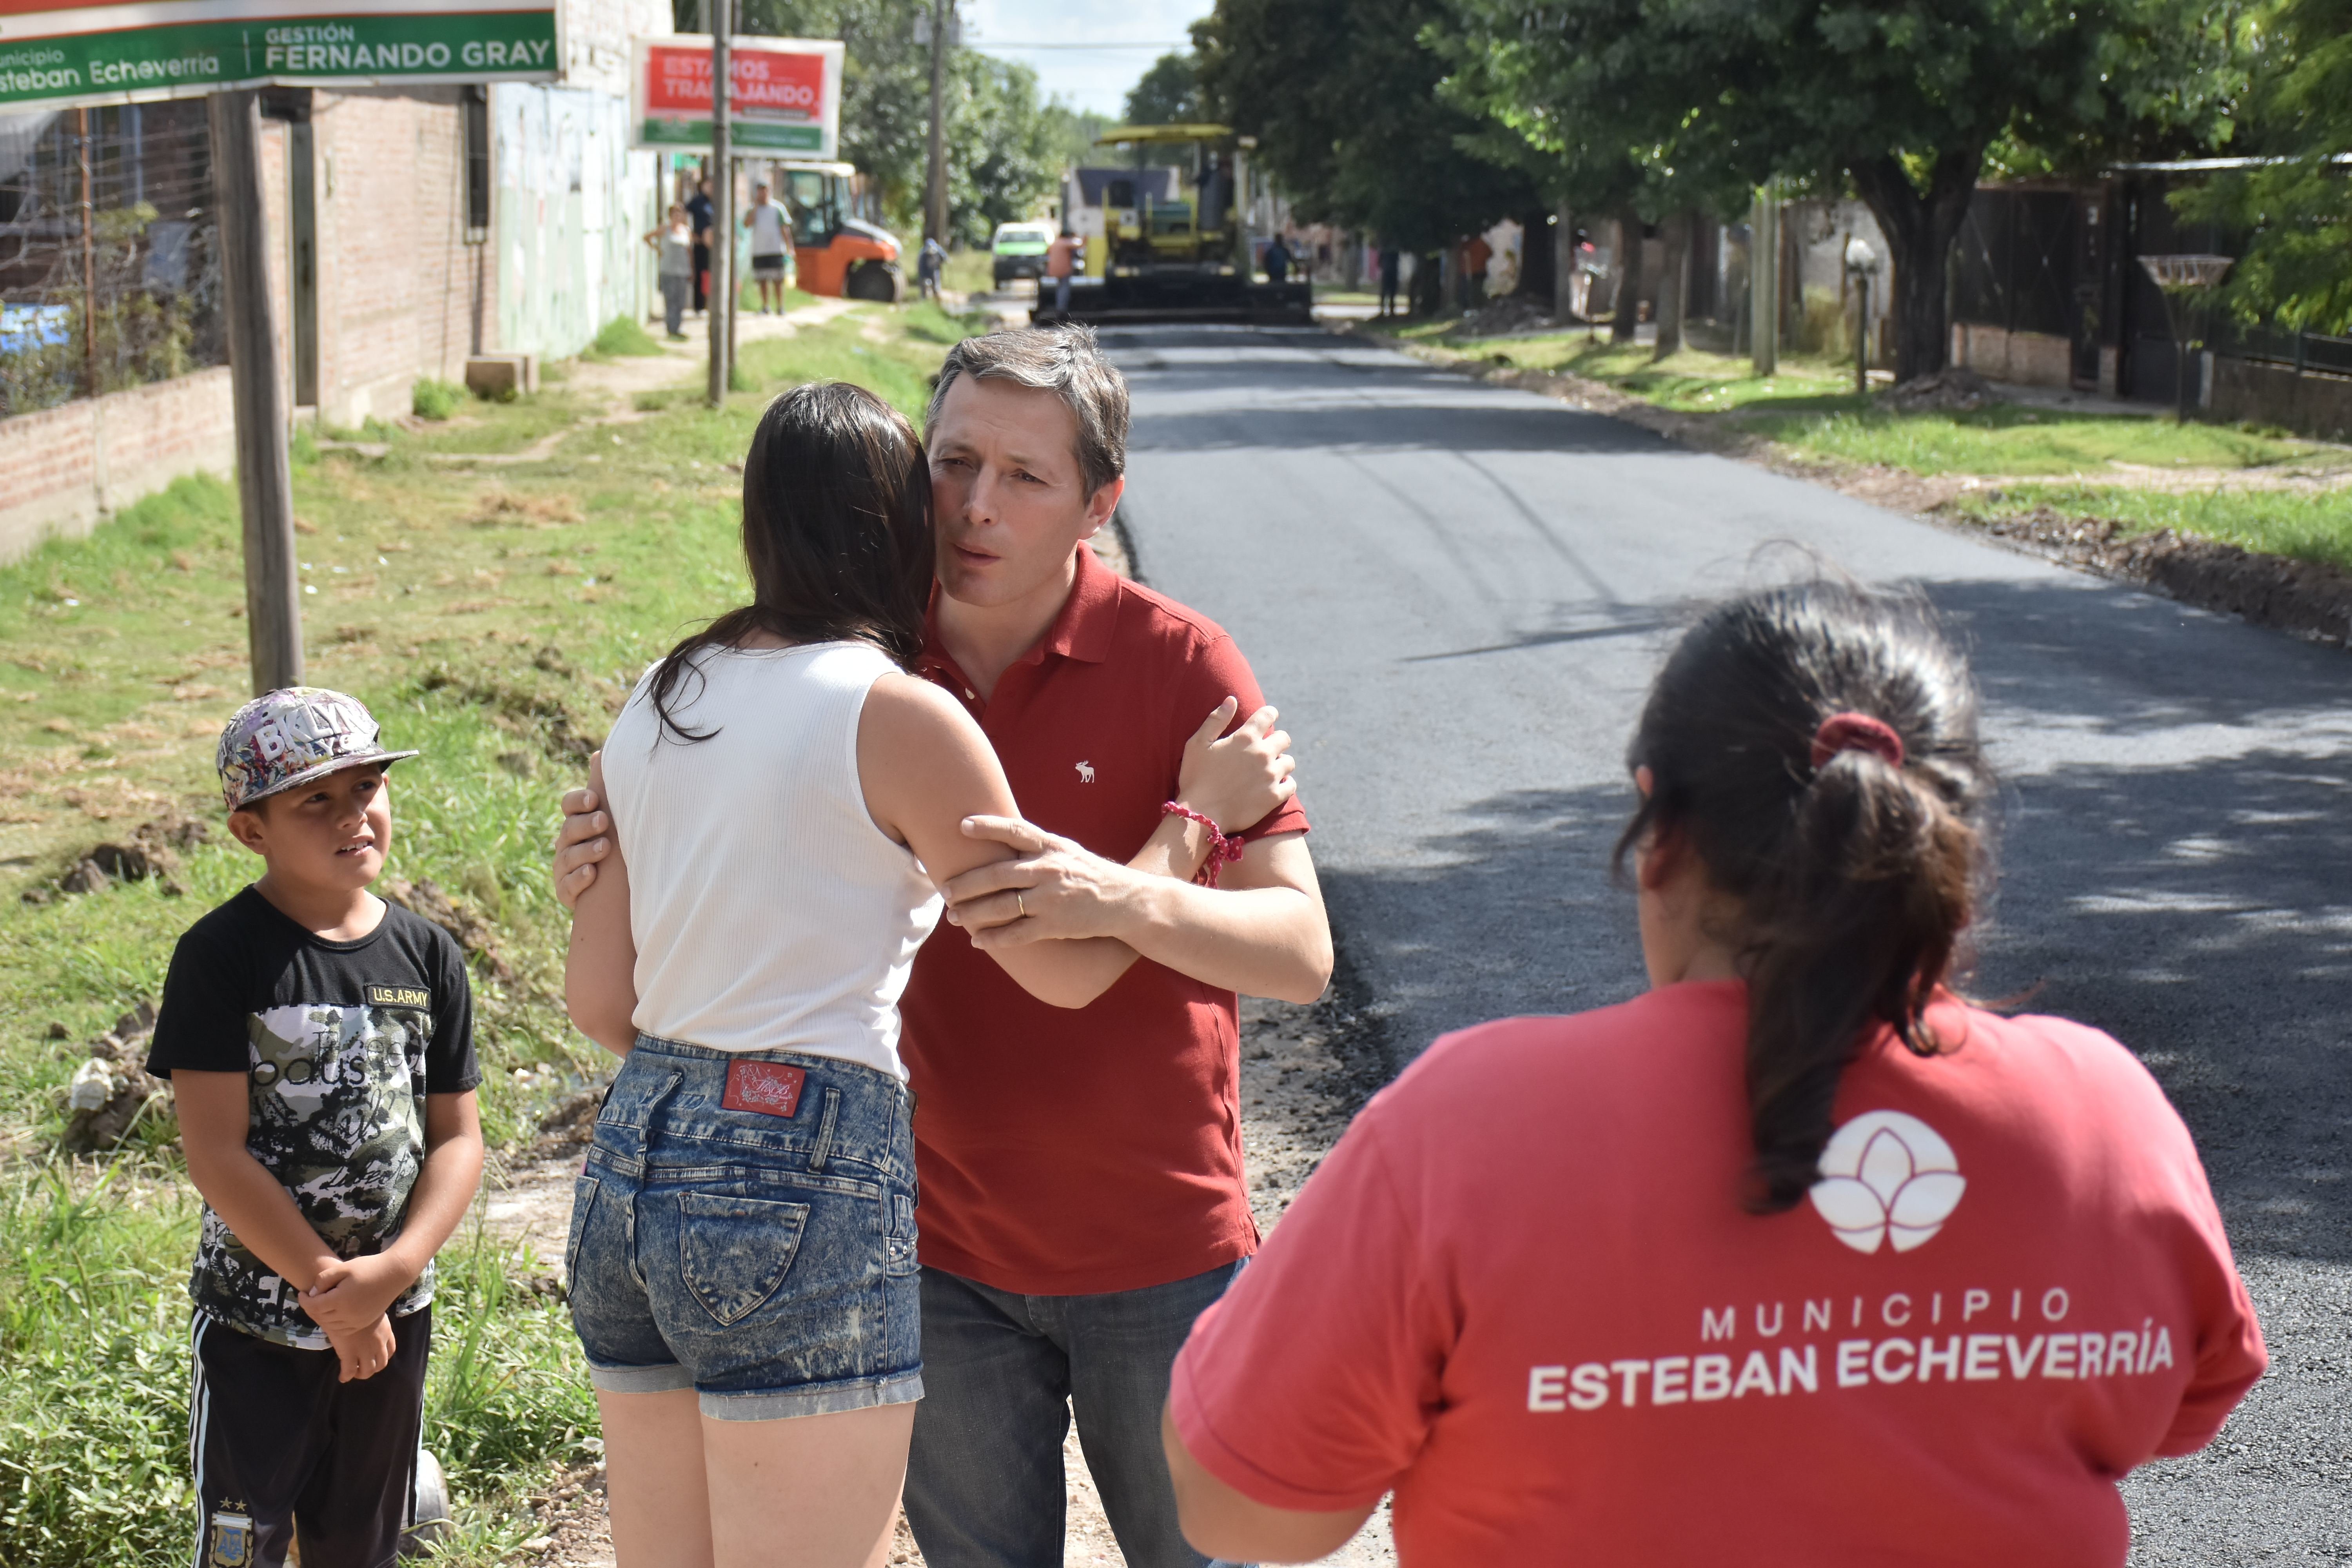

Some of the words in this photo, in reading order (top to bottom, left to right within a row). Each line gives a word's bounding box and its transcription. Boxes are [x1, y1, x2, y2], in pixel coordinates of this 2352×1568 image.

[265, 22, 354, 44] GESTIÓN
[265, 42, 452, 71] FERNANDO
[461, 38, 550, 67] GRAY
[1701, 1287, 2069, 1342] MUNICIPIO
[1528, 1345, 1818, 1412] ESTEBAN
[1836, 1318, 2173, 1387] ECHEVERRÍA
